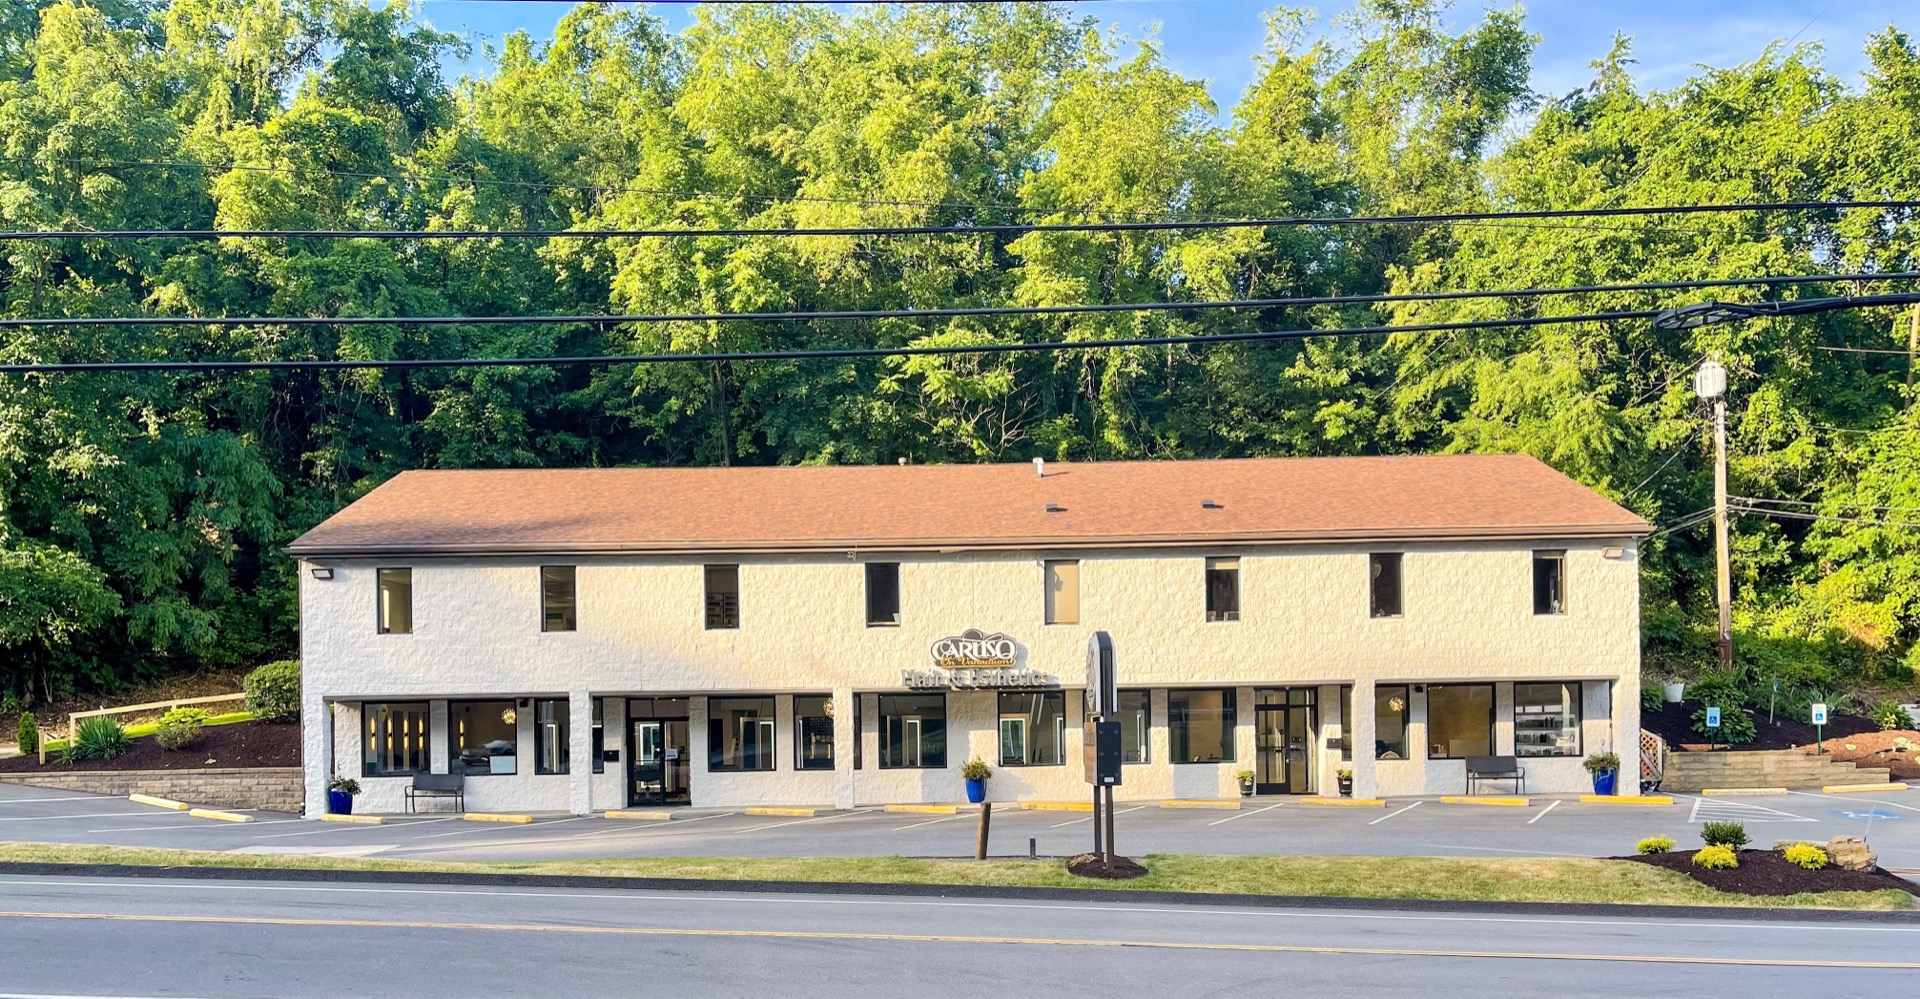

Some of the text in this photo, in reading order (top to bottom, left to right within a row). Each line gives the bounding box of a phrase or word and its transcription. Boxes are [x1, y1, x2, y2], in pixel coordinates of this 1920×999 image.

[931, 638, 1017, 660] CARUSO
[940, 656, 1013, 666] On Vanadium
[901, 668, 1048, 687] Hair & Esthetics
